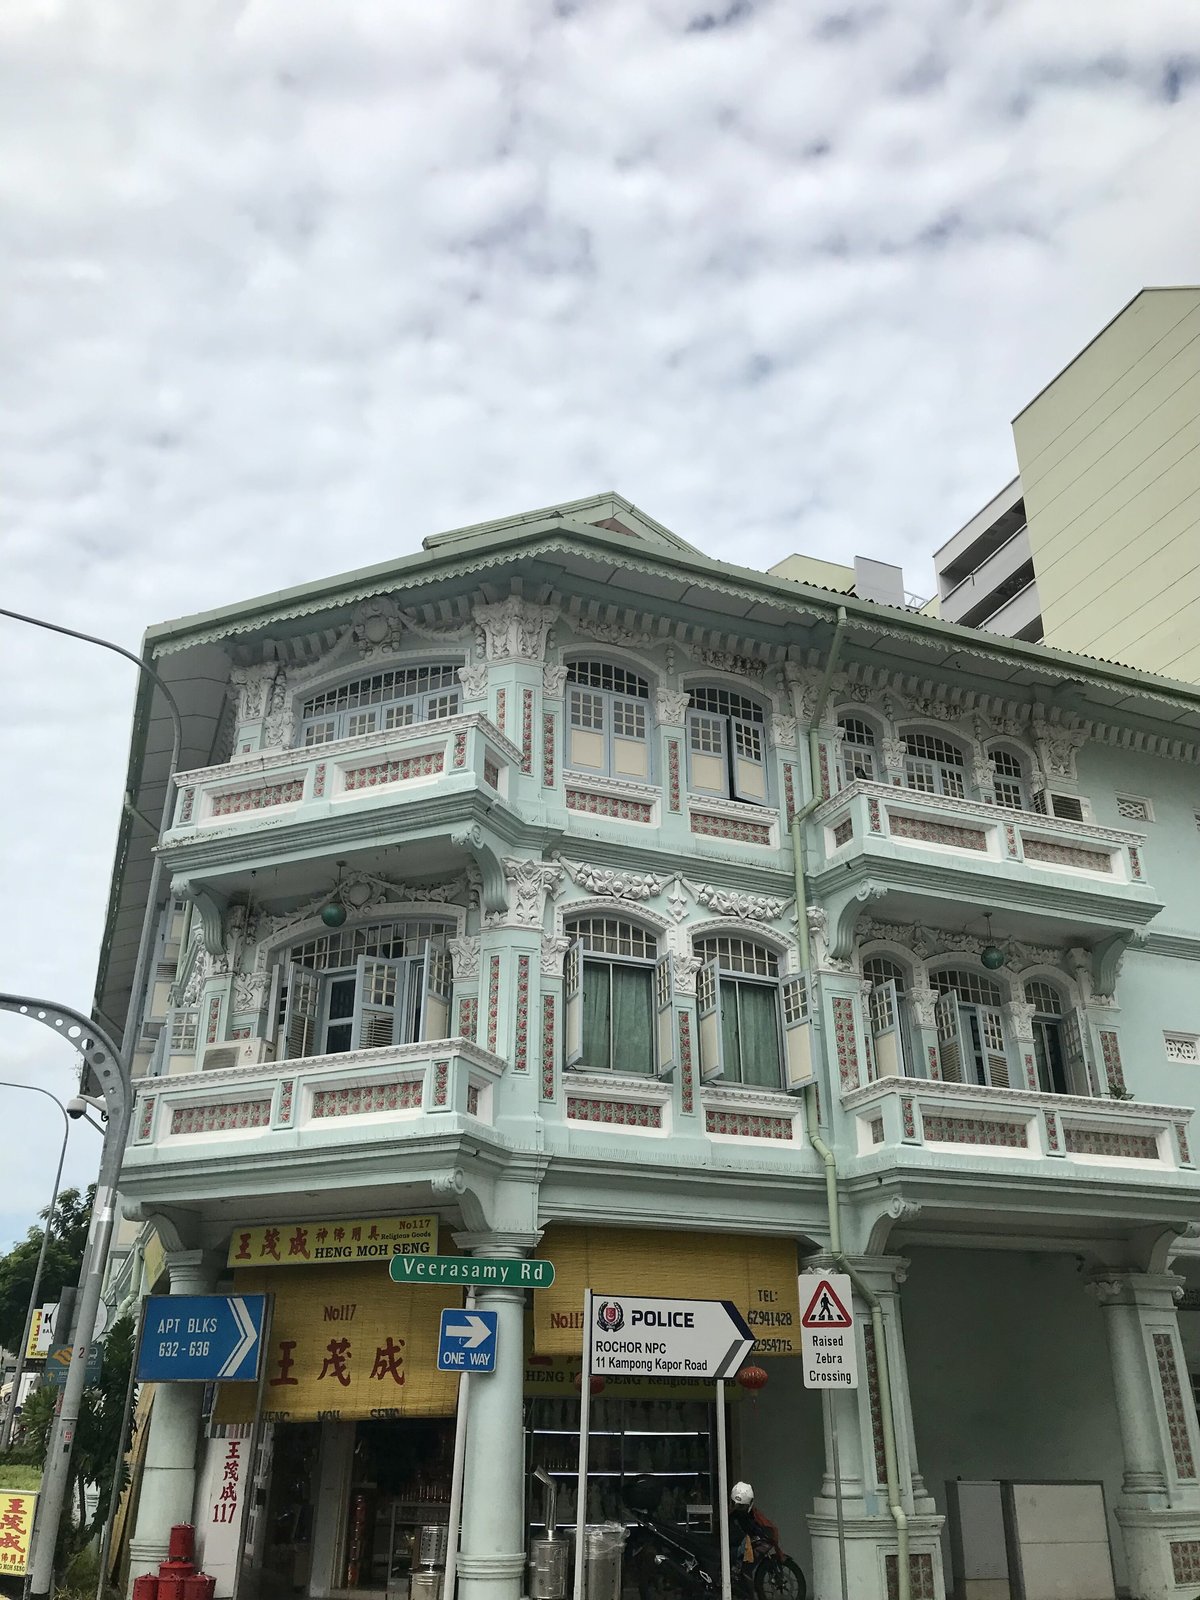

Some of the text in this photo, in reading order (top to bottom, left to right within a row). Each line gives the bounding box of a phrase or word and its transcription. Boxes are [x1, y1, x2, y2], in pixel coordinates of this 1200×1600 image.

[399, 1219, 431, 1230] No117
[380, 1232, 410, 1241] Religious
[314, 1242, 431, 1259] HENG MOH SENG
[403, 1258, 544, 1283] Veerasamy Rd
[758, 1289, 779, 1302] TEL:
[323, 1303, 357, 1321] No117
[631, 1309, 695, 1328] POLICE
[157, 1318, 218, 1334] APT BLKS
[595, 1341, 667, 1354] ROCHOR NPC
[812, 1335, 844, 1346] Raised
[78, 1347, 85, 1359] 2
[443, 1351, 491, 1366] ONE WAY
[816, 1353, 843, 1364] Zebra
[595, 1357, 605, 1368] 11
[608, 1357, 653, 1373] Kampong
[655, 1357, 683, 1371] Kapor
[684, 1358, 708, 1371] Road
[524, 1370, 565, 1382] HENG
[809, 1370, 852, 1385] Crossing
[220, 1441, 241, 1502] 王茂成
[212, 1502, 237, 1524] 117
